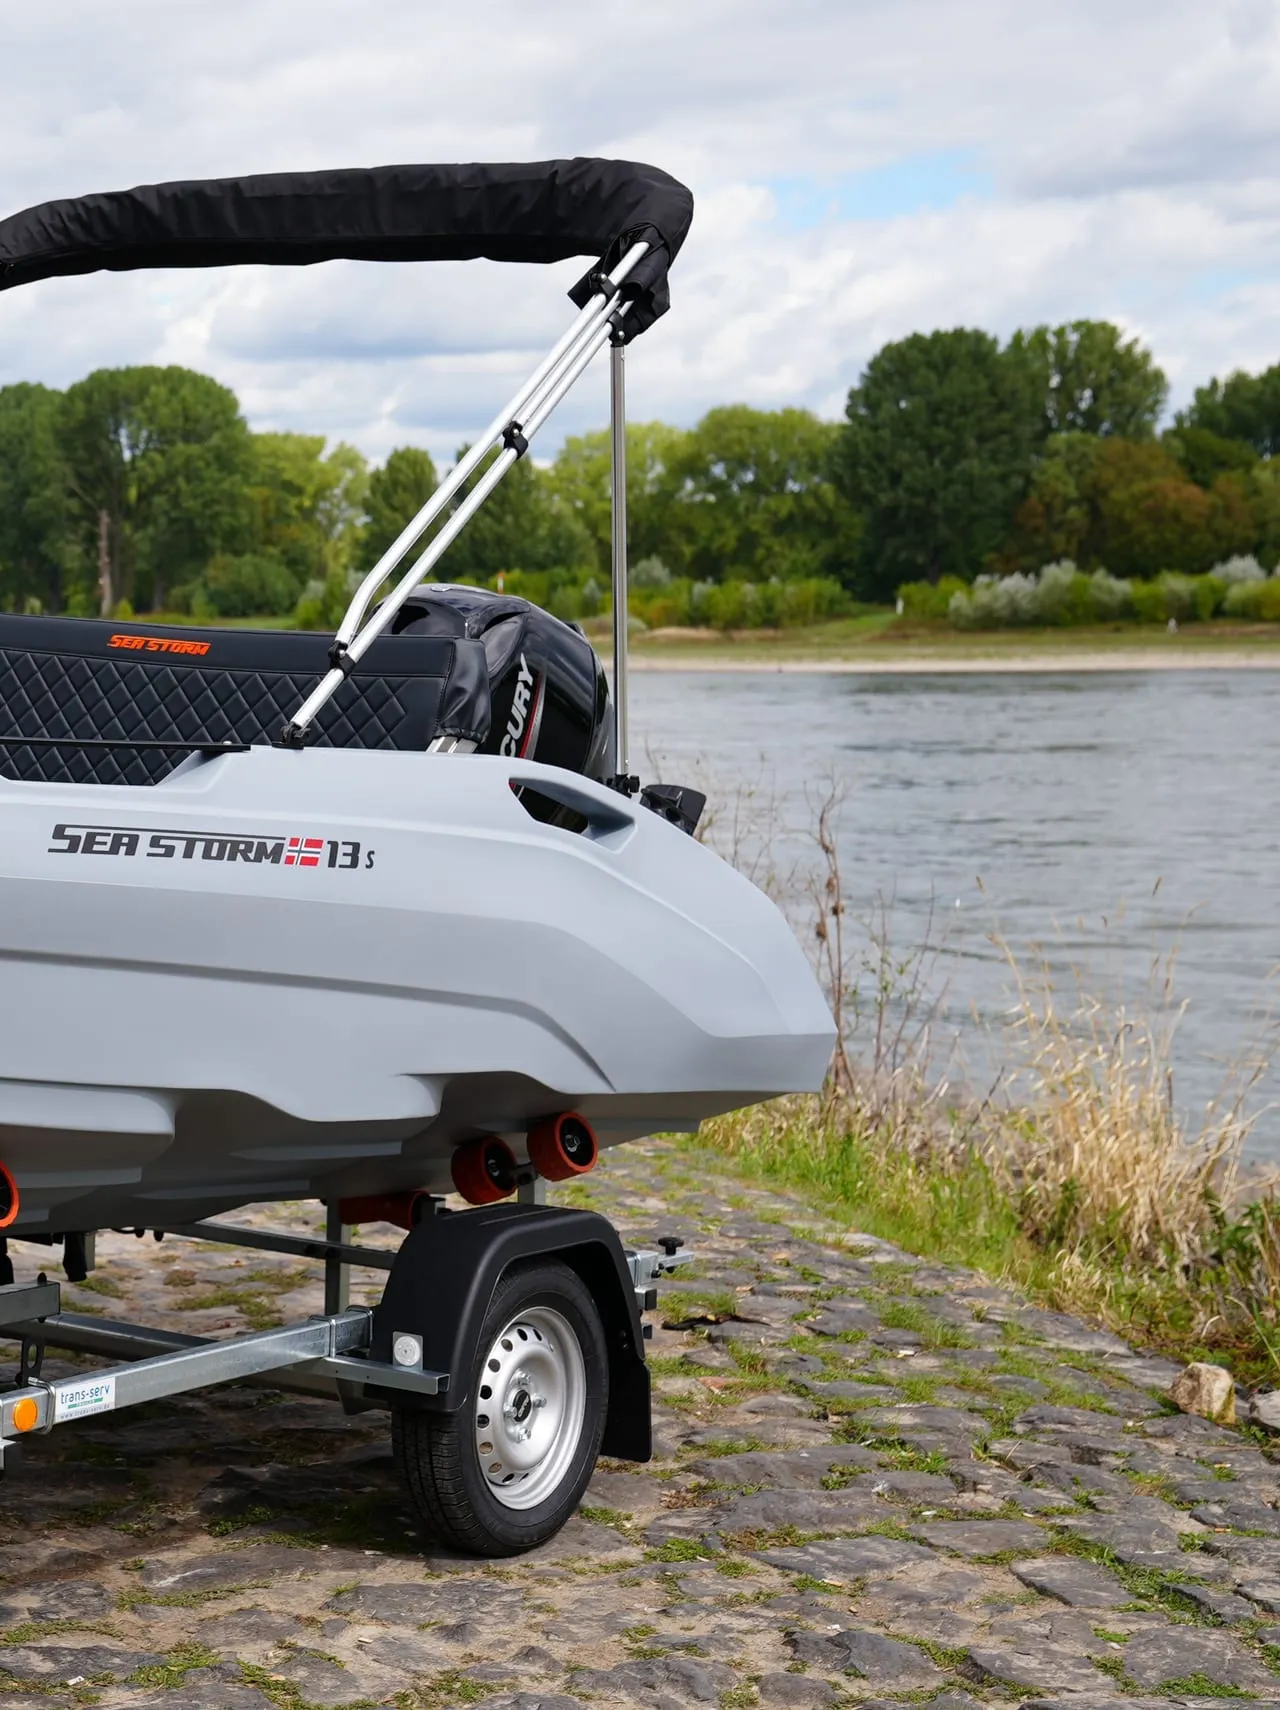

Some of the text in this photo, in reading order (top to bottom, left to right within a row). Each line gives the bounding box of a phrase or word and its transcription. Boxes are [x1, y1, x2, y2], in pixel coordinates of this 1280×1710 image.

[107, 634, 212, 656] SEA STORM
[47, 823, 140, 857] SEA
[146, 831, 286, 865] STORM
[60, 1384, 110, 1405] trans-serv
